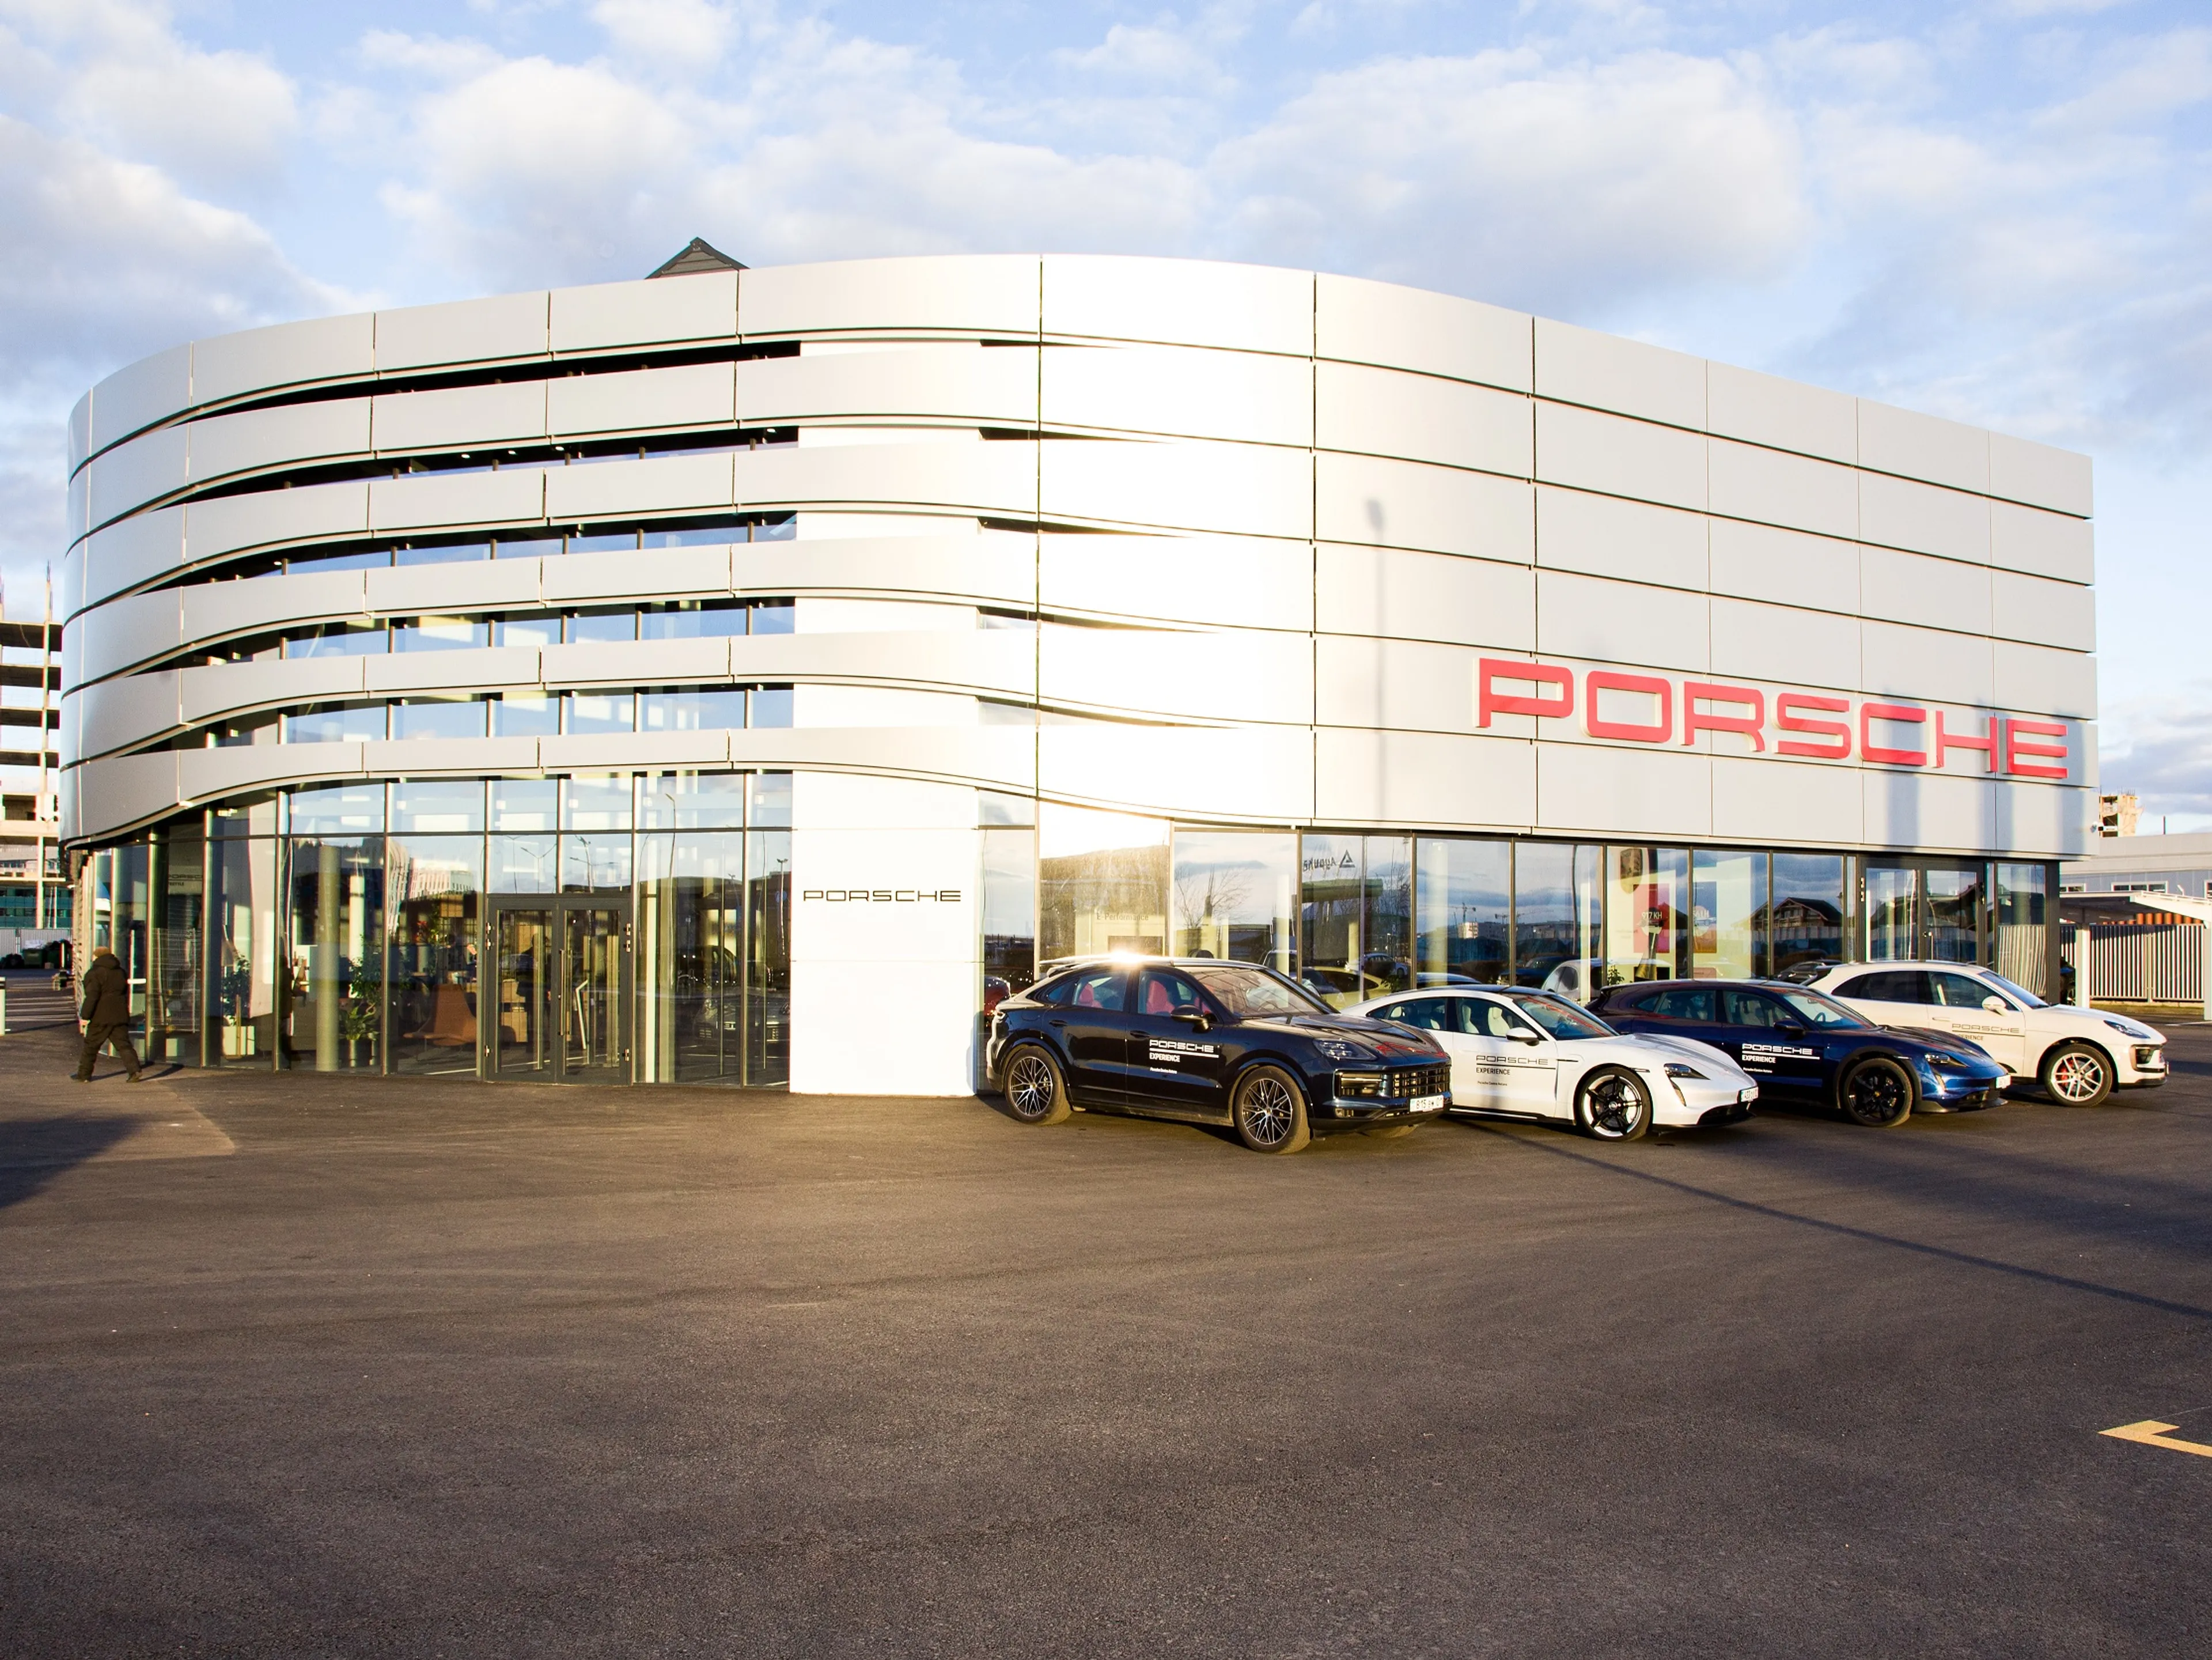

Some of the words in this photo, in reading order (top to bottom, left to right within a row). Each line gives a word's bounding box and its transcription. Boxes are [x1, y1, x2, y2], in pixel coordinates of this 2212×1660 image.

[1475, 657, 2069, 779] PORSCHE
[804, 890, 961, 902] PORSCHE
[1097, 913, 1149, 921] E-Performance
[1952, 1023, 2020, 1033] PORSCHE
[1149, 1039, 1214, 1053] PORSCHE
[1742, 1043, 1813, 1055] PORSCHE
[1149, 1052, 1180, 1062] EXPERIENCE
[1476, 1055, 1548, 1065] PORSCHE
[1742, 1054, 1776, 1063] EXPERIENCE
